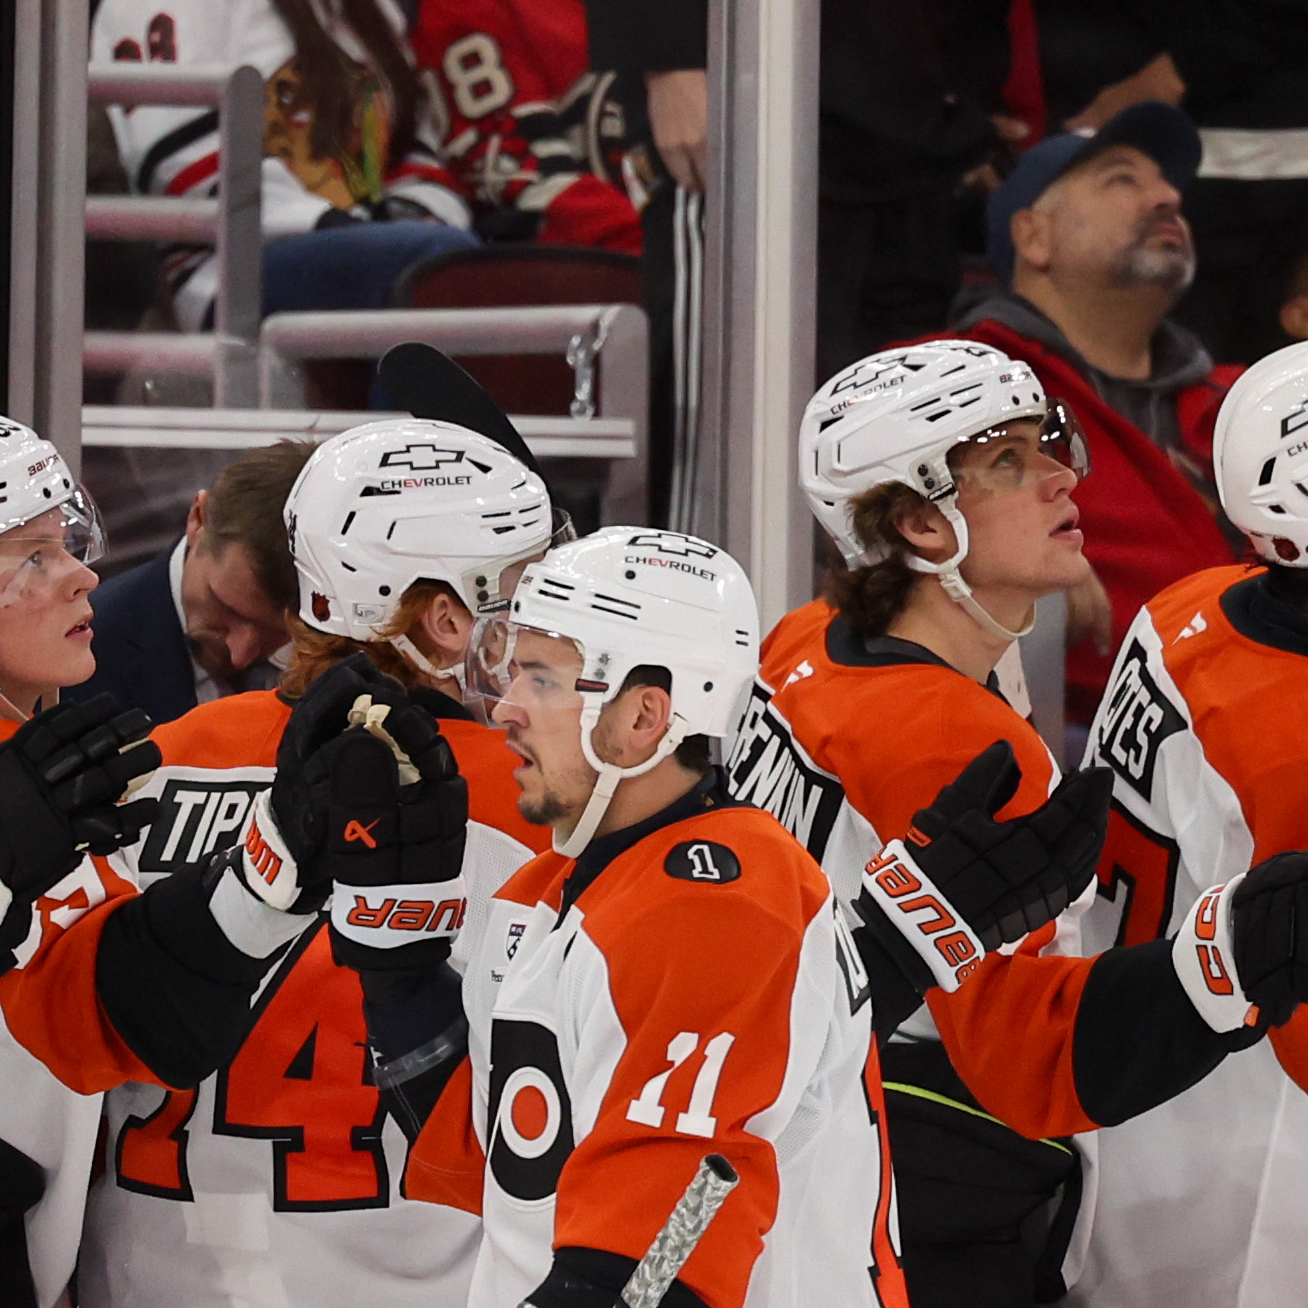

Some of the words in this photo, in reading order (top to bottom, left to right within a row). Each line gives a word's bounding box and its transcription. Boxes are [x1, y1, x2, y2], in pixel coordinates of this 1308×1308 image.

[381, 475, 473, 490] CHEVROLET
[624, 555, 718, 583] CHEVROLET
[687, 844, 721, 880] 1
[625, 1030, 737, 1139] 11
